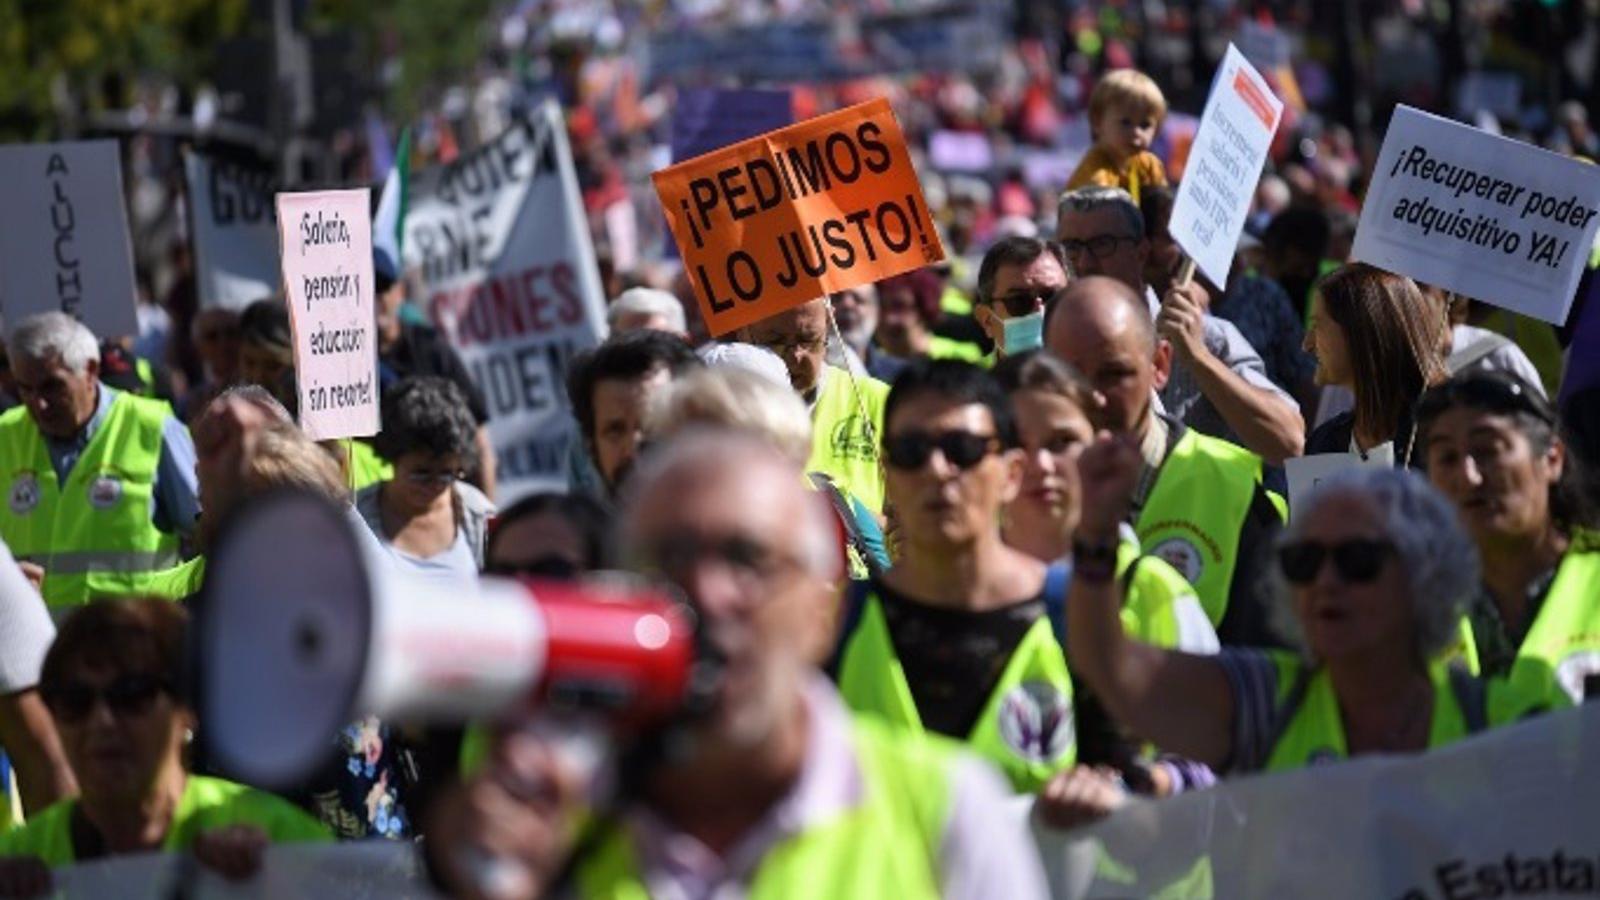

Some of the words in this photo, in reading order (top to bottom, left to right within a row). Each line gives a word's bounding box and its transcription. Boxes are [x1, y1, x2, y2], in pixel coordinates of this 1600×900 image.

[681, 121, 892, 248] ¡PEDIMOS
[1391, 145, 1526, 207] ¡Recuperar
[1520, 191, 1598, 230] poder
[697, 252, 764, 314] LO
[776, 195, 929, 288] JUSTO!
[1393, 197, 1520, 254] adquisitivo
[1527, 231, 1570, 268] YA!
[309, 379, 327, 411] sin
[1433, 845, 1600, 900] Estata
